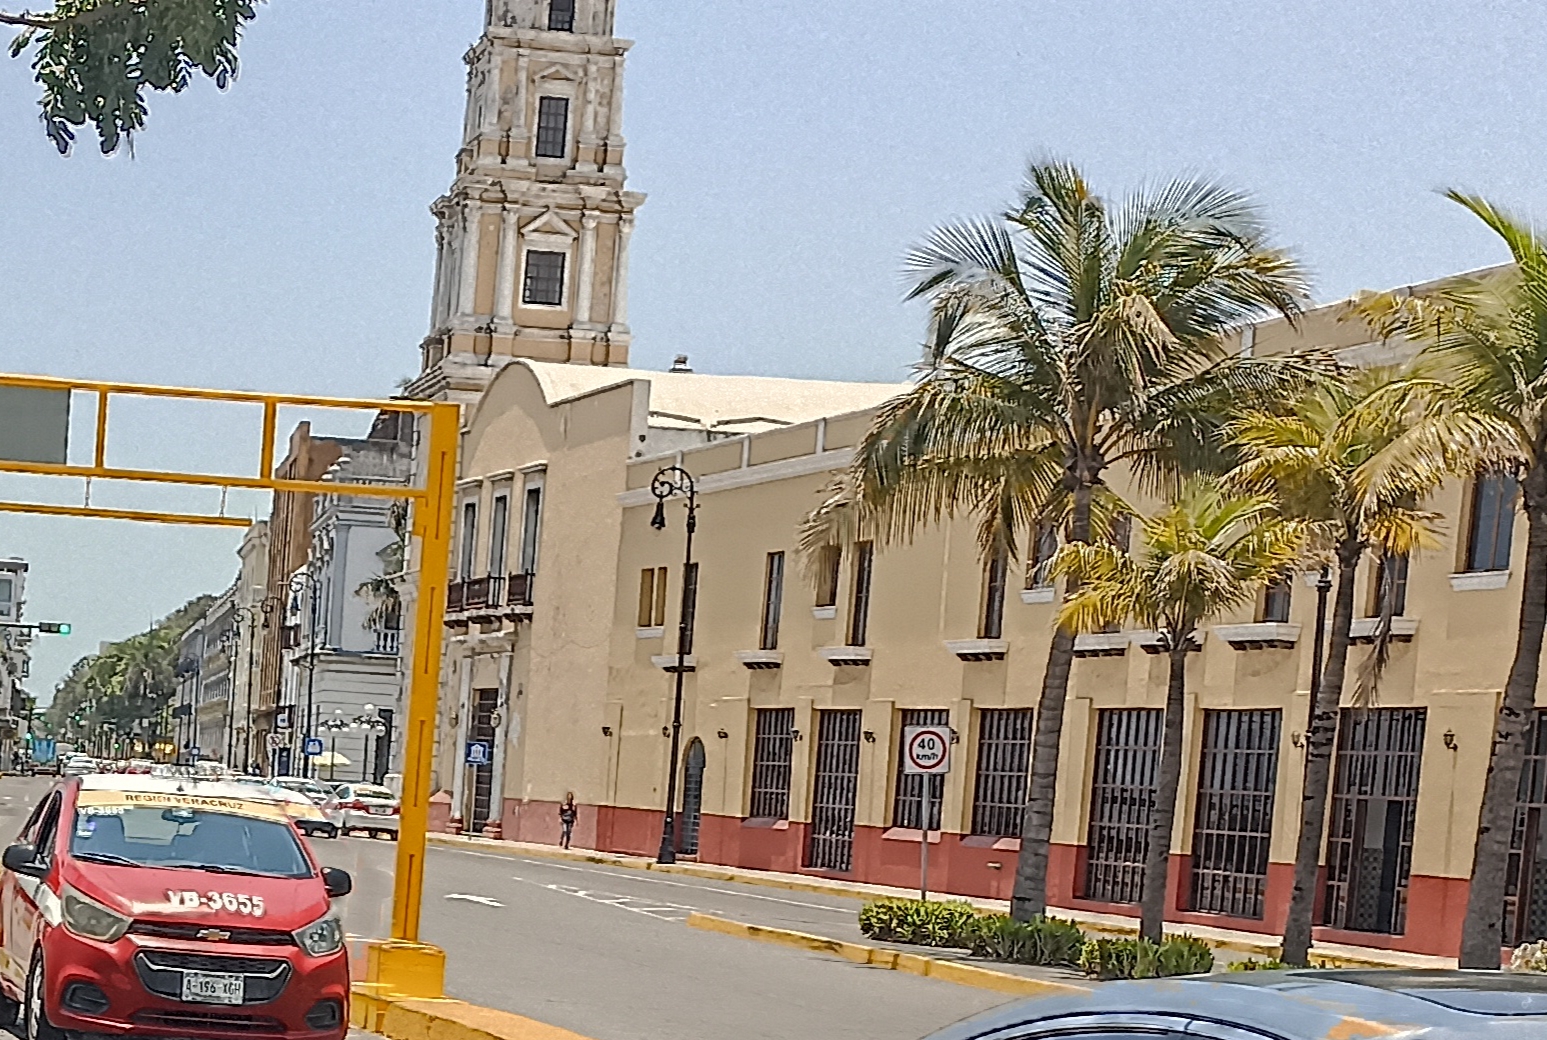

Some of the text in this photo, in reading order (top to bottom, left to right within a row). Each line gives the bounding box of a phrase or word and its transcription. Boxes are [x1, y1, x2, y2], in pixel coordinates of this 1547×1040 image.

[917, 737, 936, 751] 40
[915, 752, 939, 761] km/h
[173, 796, 244, 810] VERACRUZ
[166, 889, 266, 918] VB-3655
